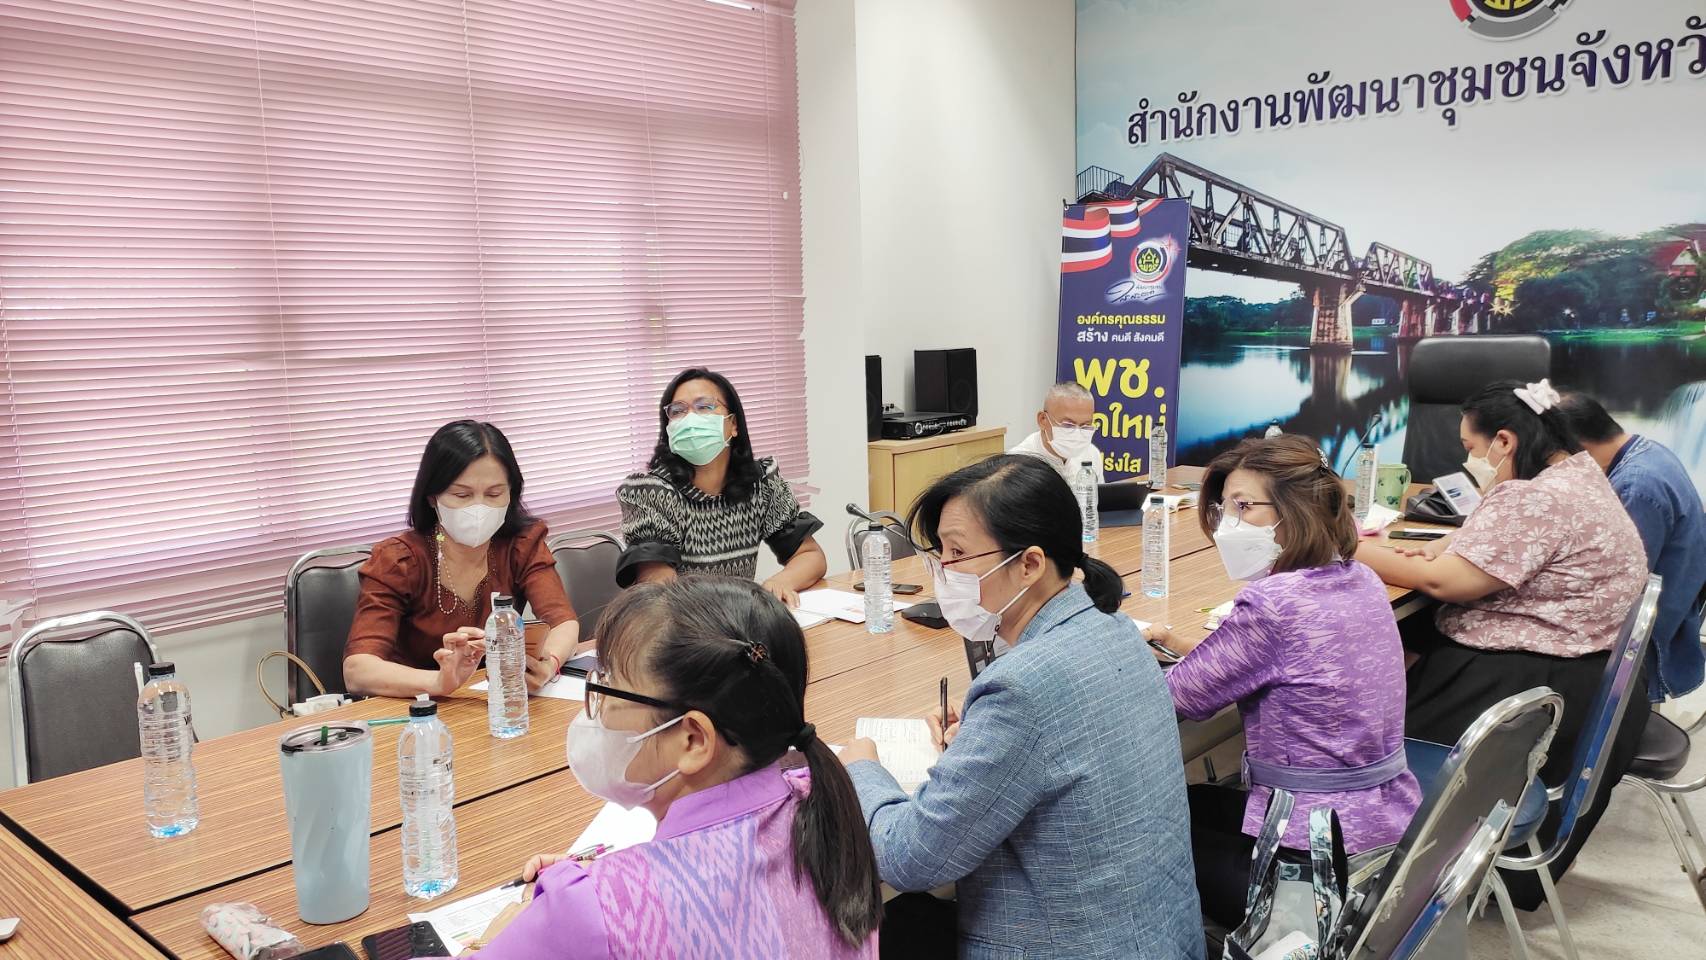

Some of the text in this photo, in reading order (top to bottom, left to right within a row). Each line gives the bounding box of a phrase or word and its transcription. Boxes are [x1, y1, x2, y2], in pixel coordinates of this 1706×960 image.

[1077, 312, 1165, 329] องค์กรคุณธรรม
[1077, 327, 1108, 342] สร้าง
[1074, 358, 1165, 398] พช.
